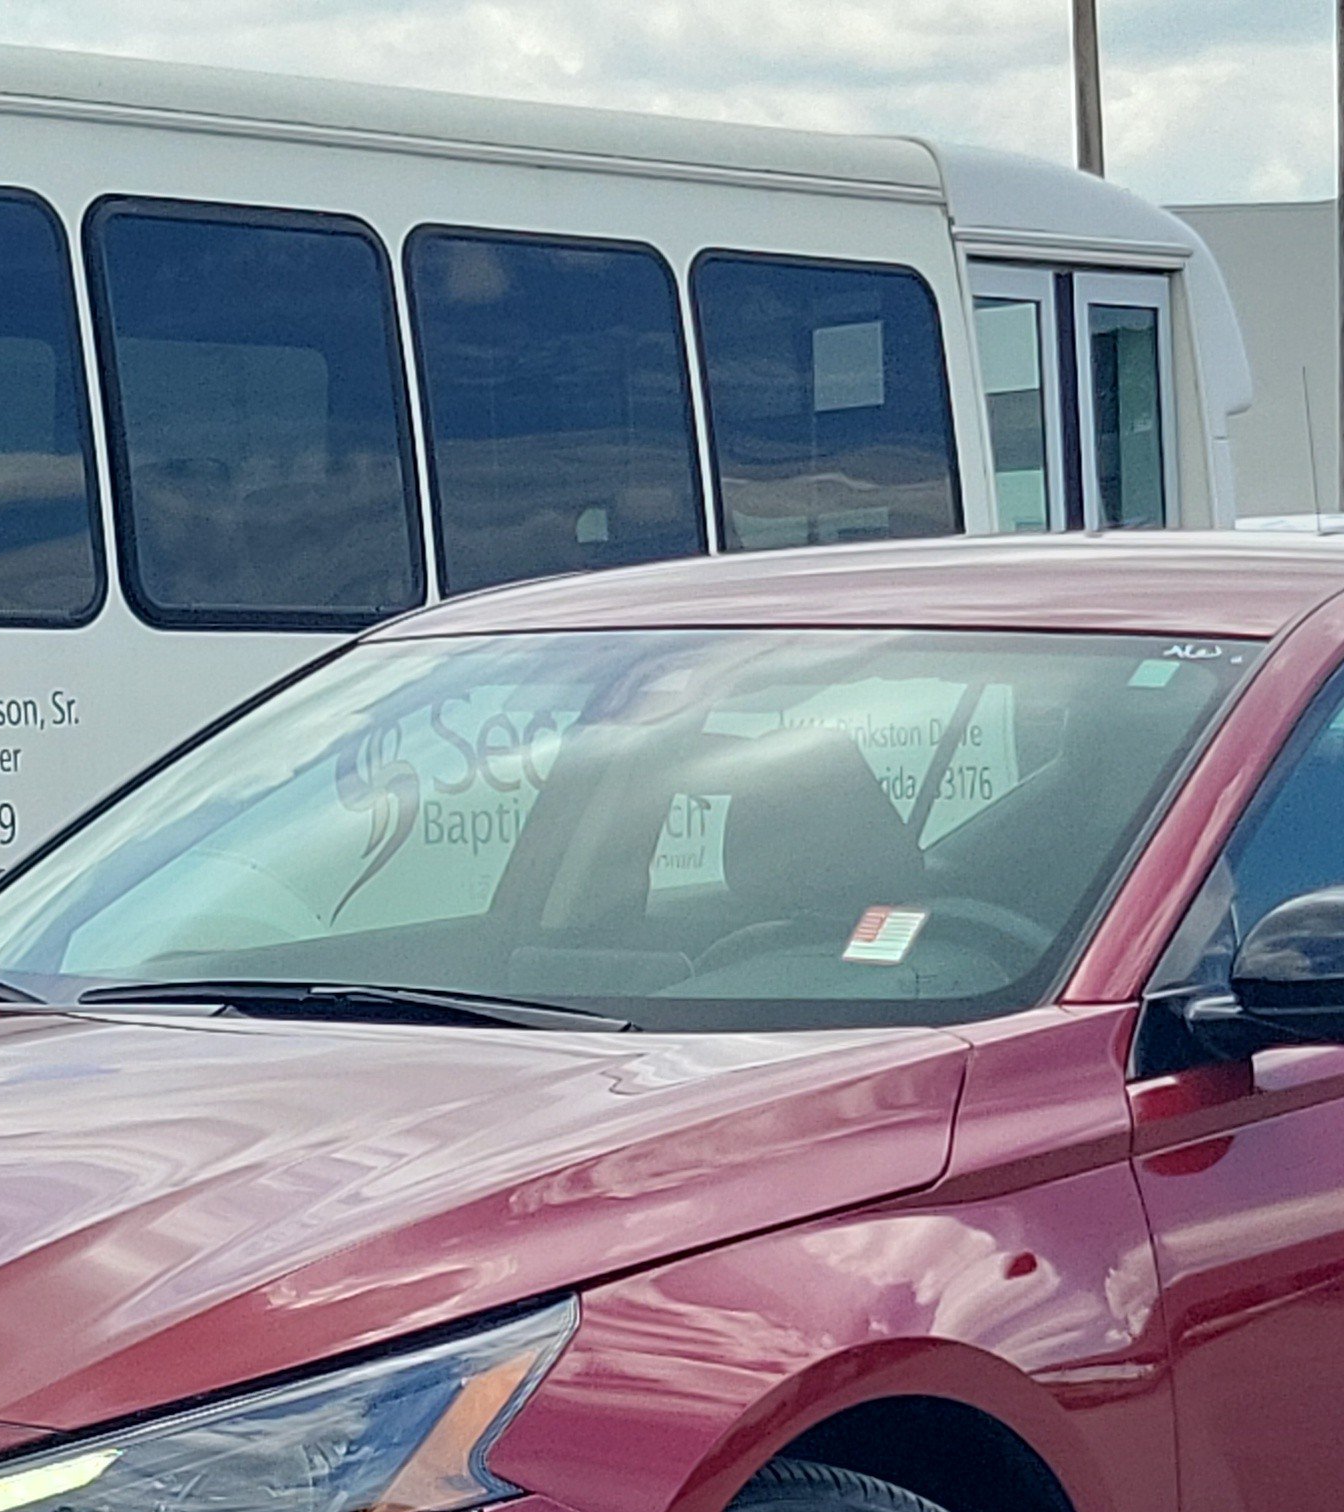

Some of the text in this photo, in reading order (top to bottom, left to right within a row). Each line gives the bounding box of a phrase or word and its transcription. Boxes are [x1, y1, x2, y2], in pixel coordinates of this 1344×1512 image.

[51, 690, 80, 725] Sr.
[936, 766, 993, 801] 3176
[423, 797, 521, 857] Bapti
